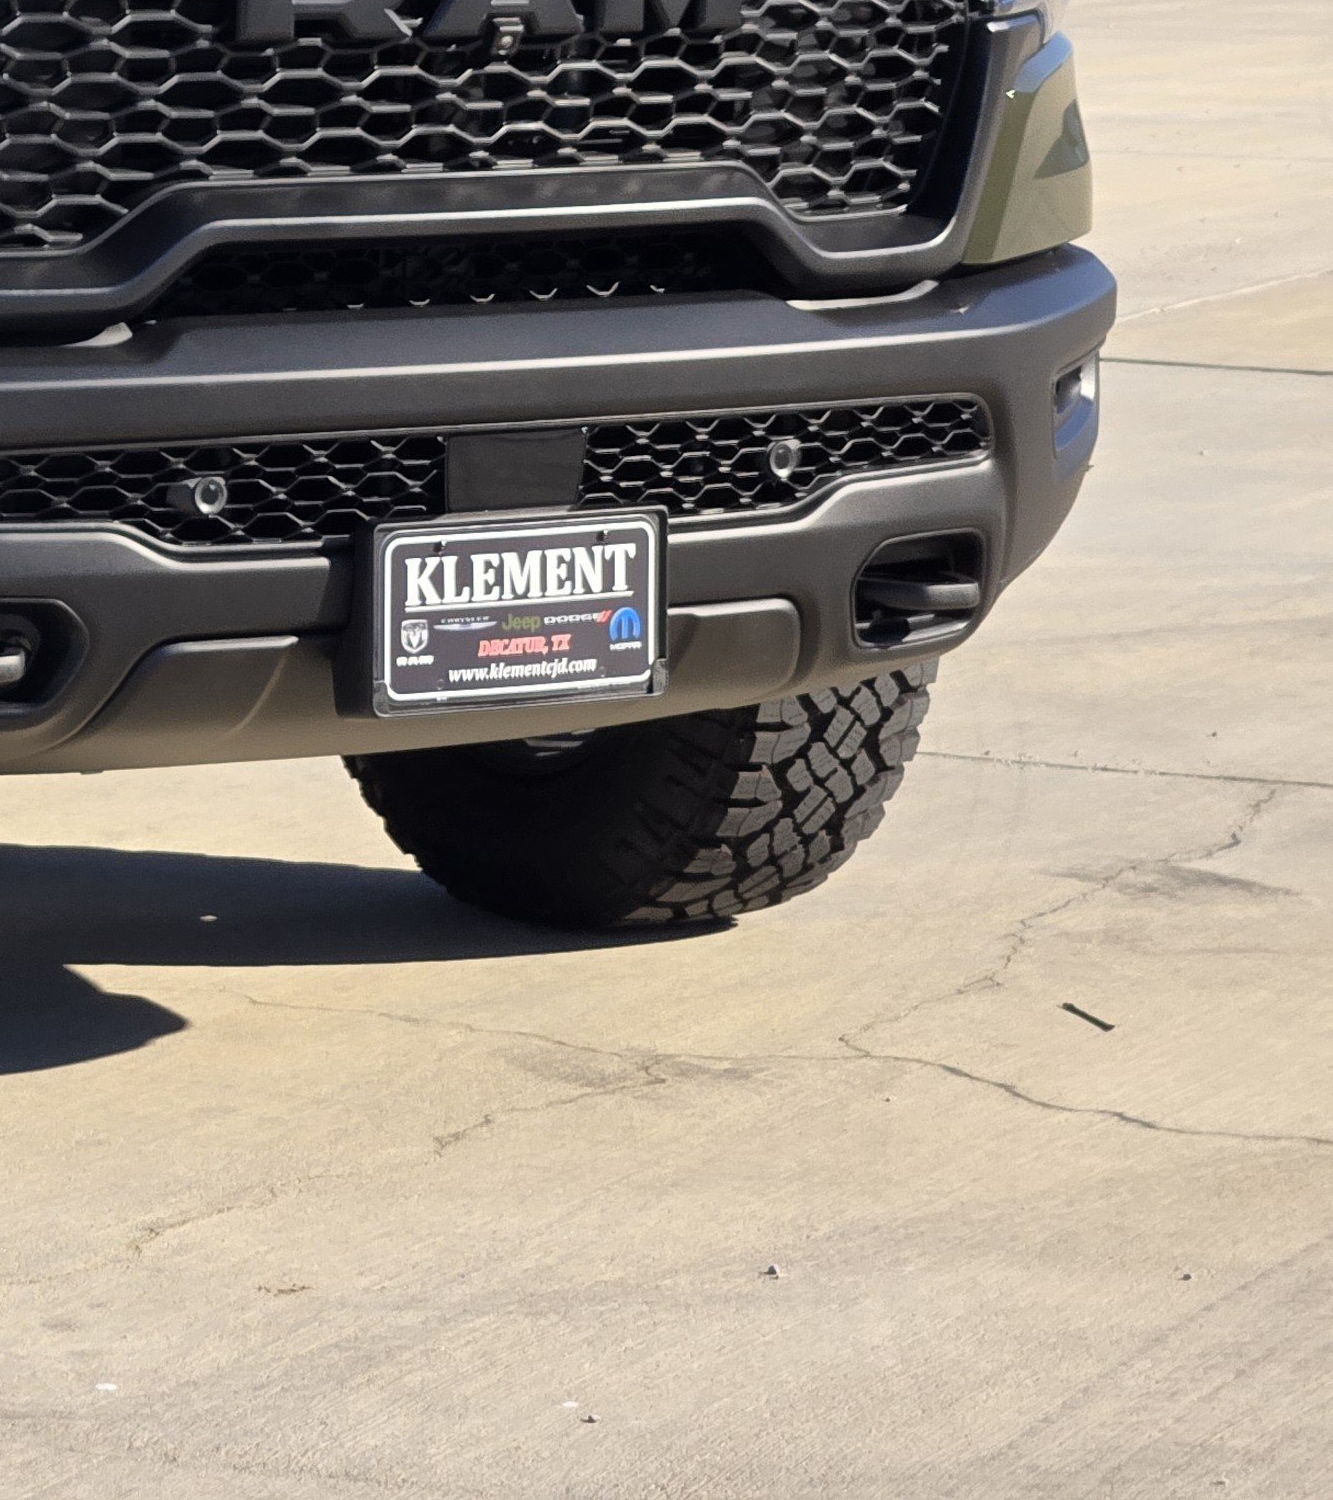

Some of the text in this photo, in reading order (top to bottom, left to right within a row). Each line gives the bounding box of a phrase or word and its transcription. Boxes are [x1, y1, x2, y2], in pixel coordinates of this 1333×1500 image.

[404, 543, 637, 607] KLEMENT
[501, 612, 541, 632] Jeep
[551, 633, 571, 651] TX
[448, 657, 597, 683] www.klementcjd.com
